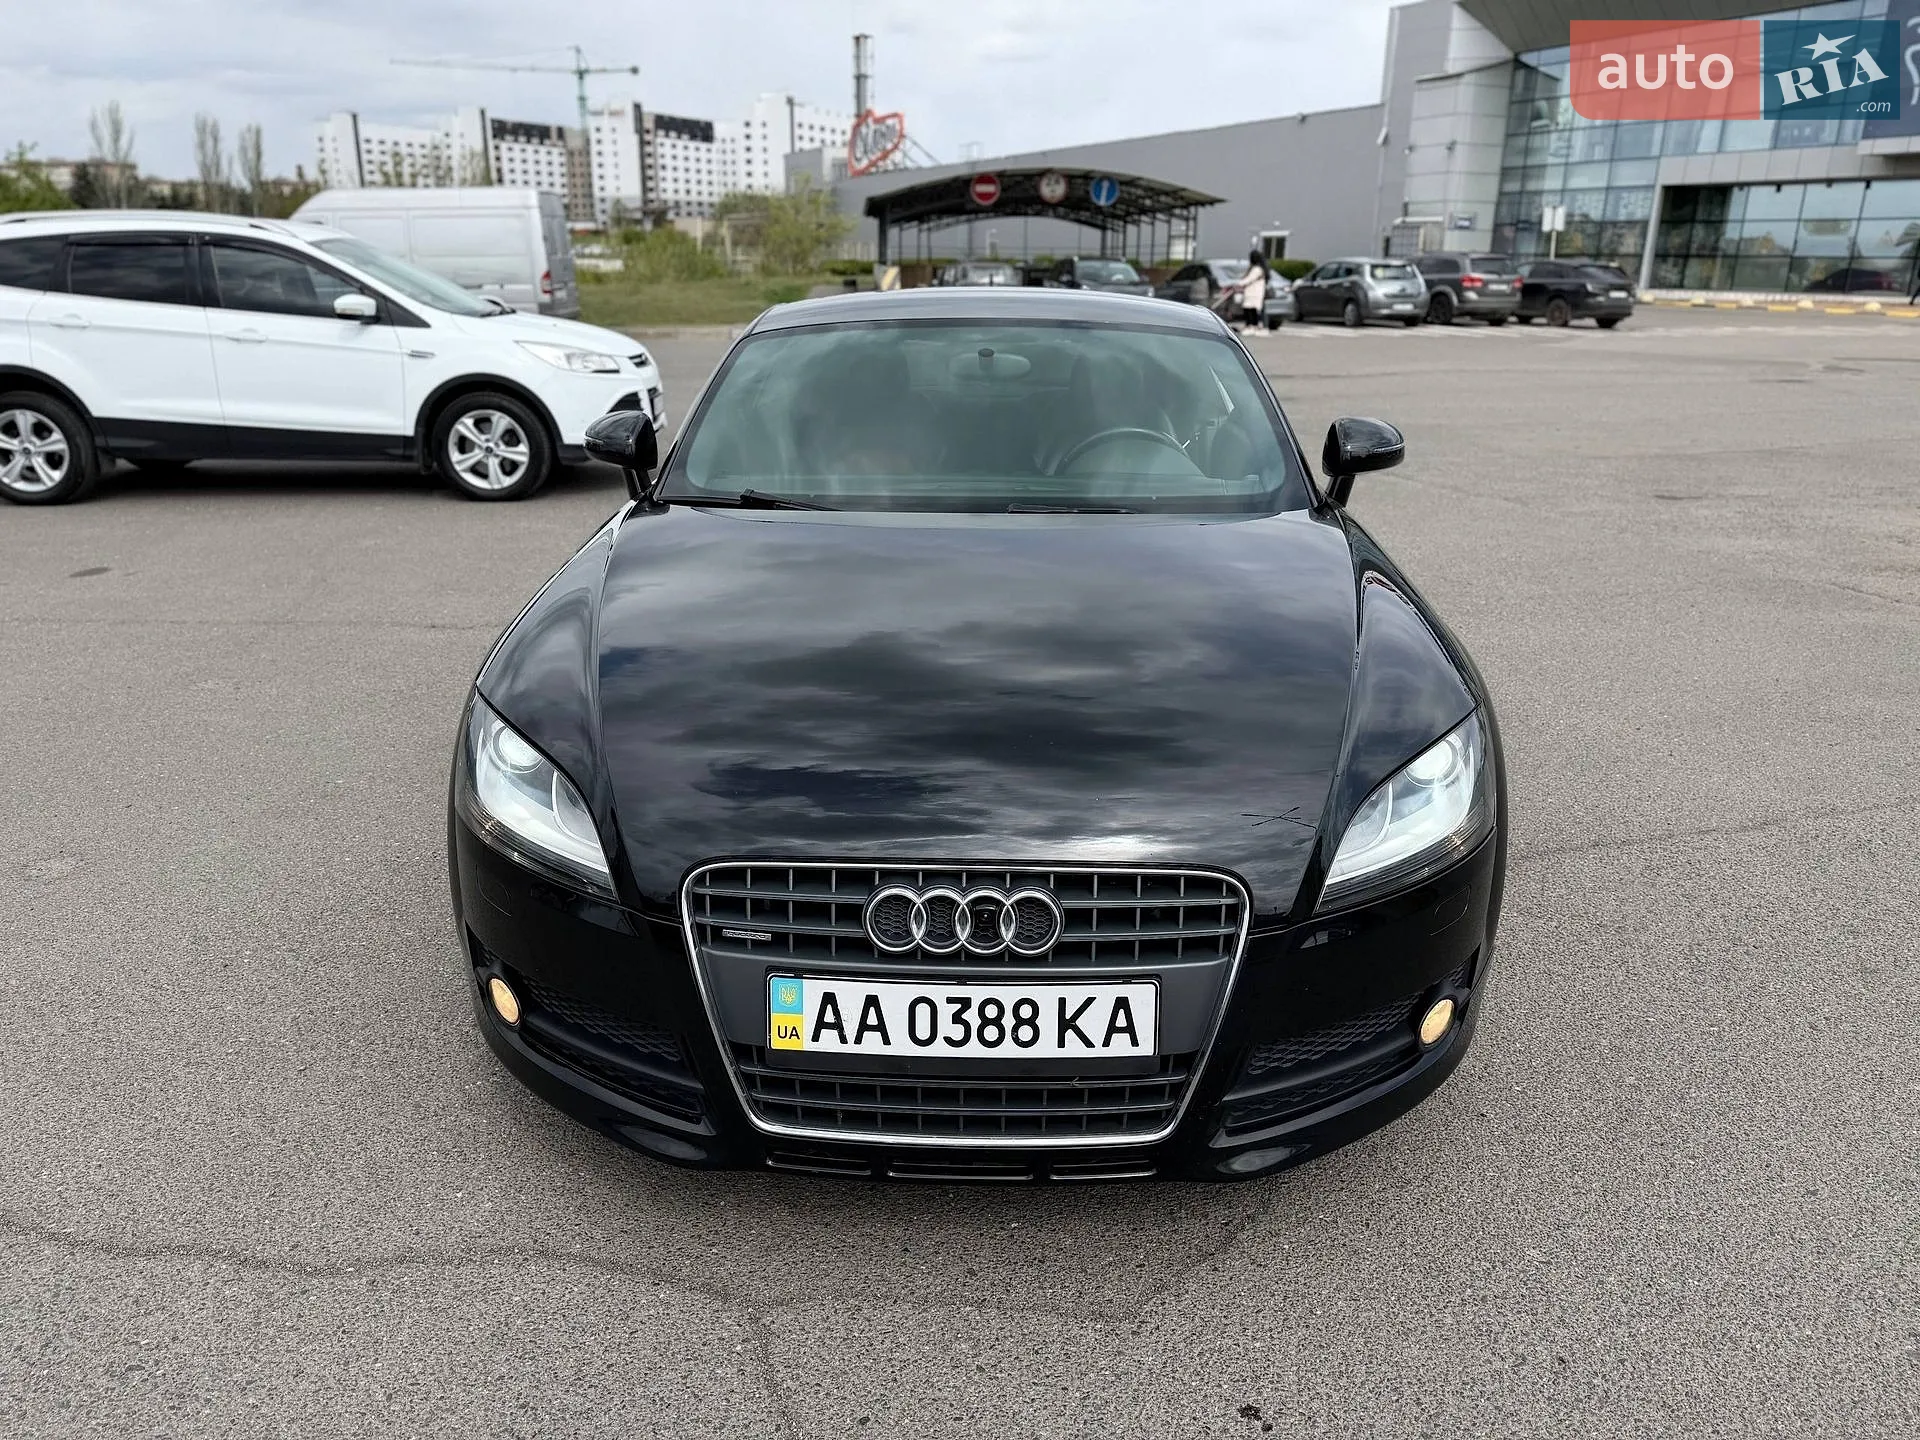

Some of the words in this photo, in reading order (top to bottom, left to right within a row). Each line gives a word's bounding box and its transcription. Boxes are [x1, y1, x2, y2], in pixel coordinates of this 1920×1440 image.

[777, 1025, 801, 1040] UA
[811, 992, 892, 1046] AA
[907, 996, 1041, 1049] 0388
[1057, 996, 1140, 1049] KA
